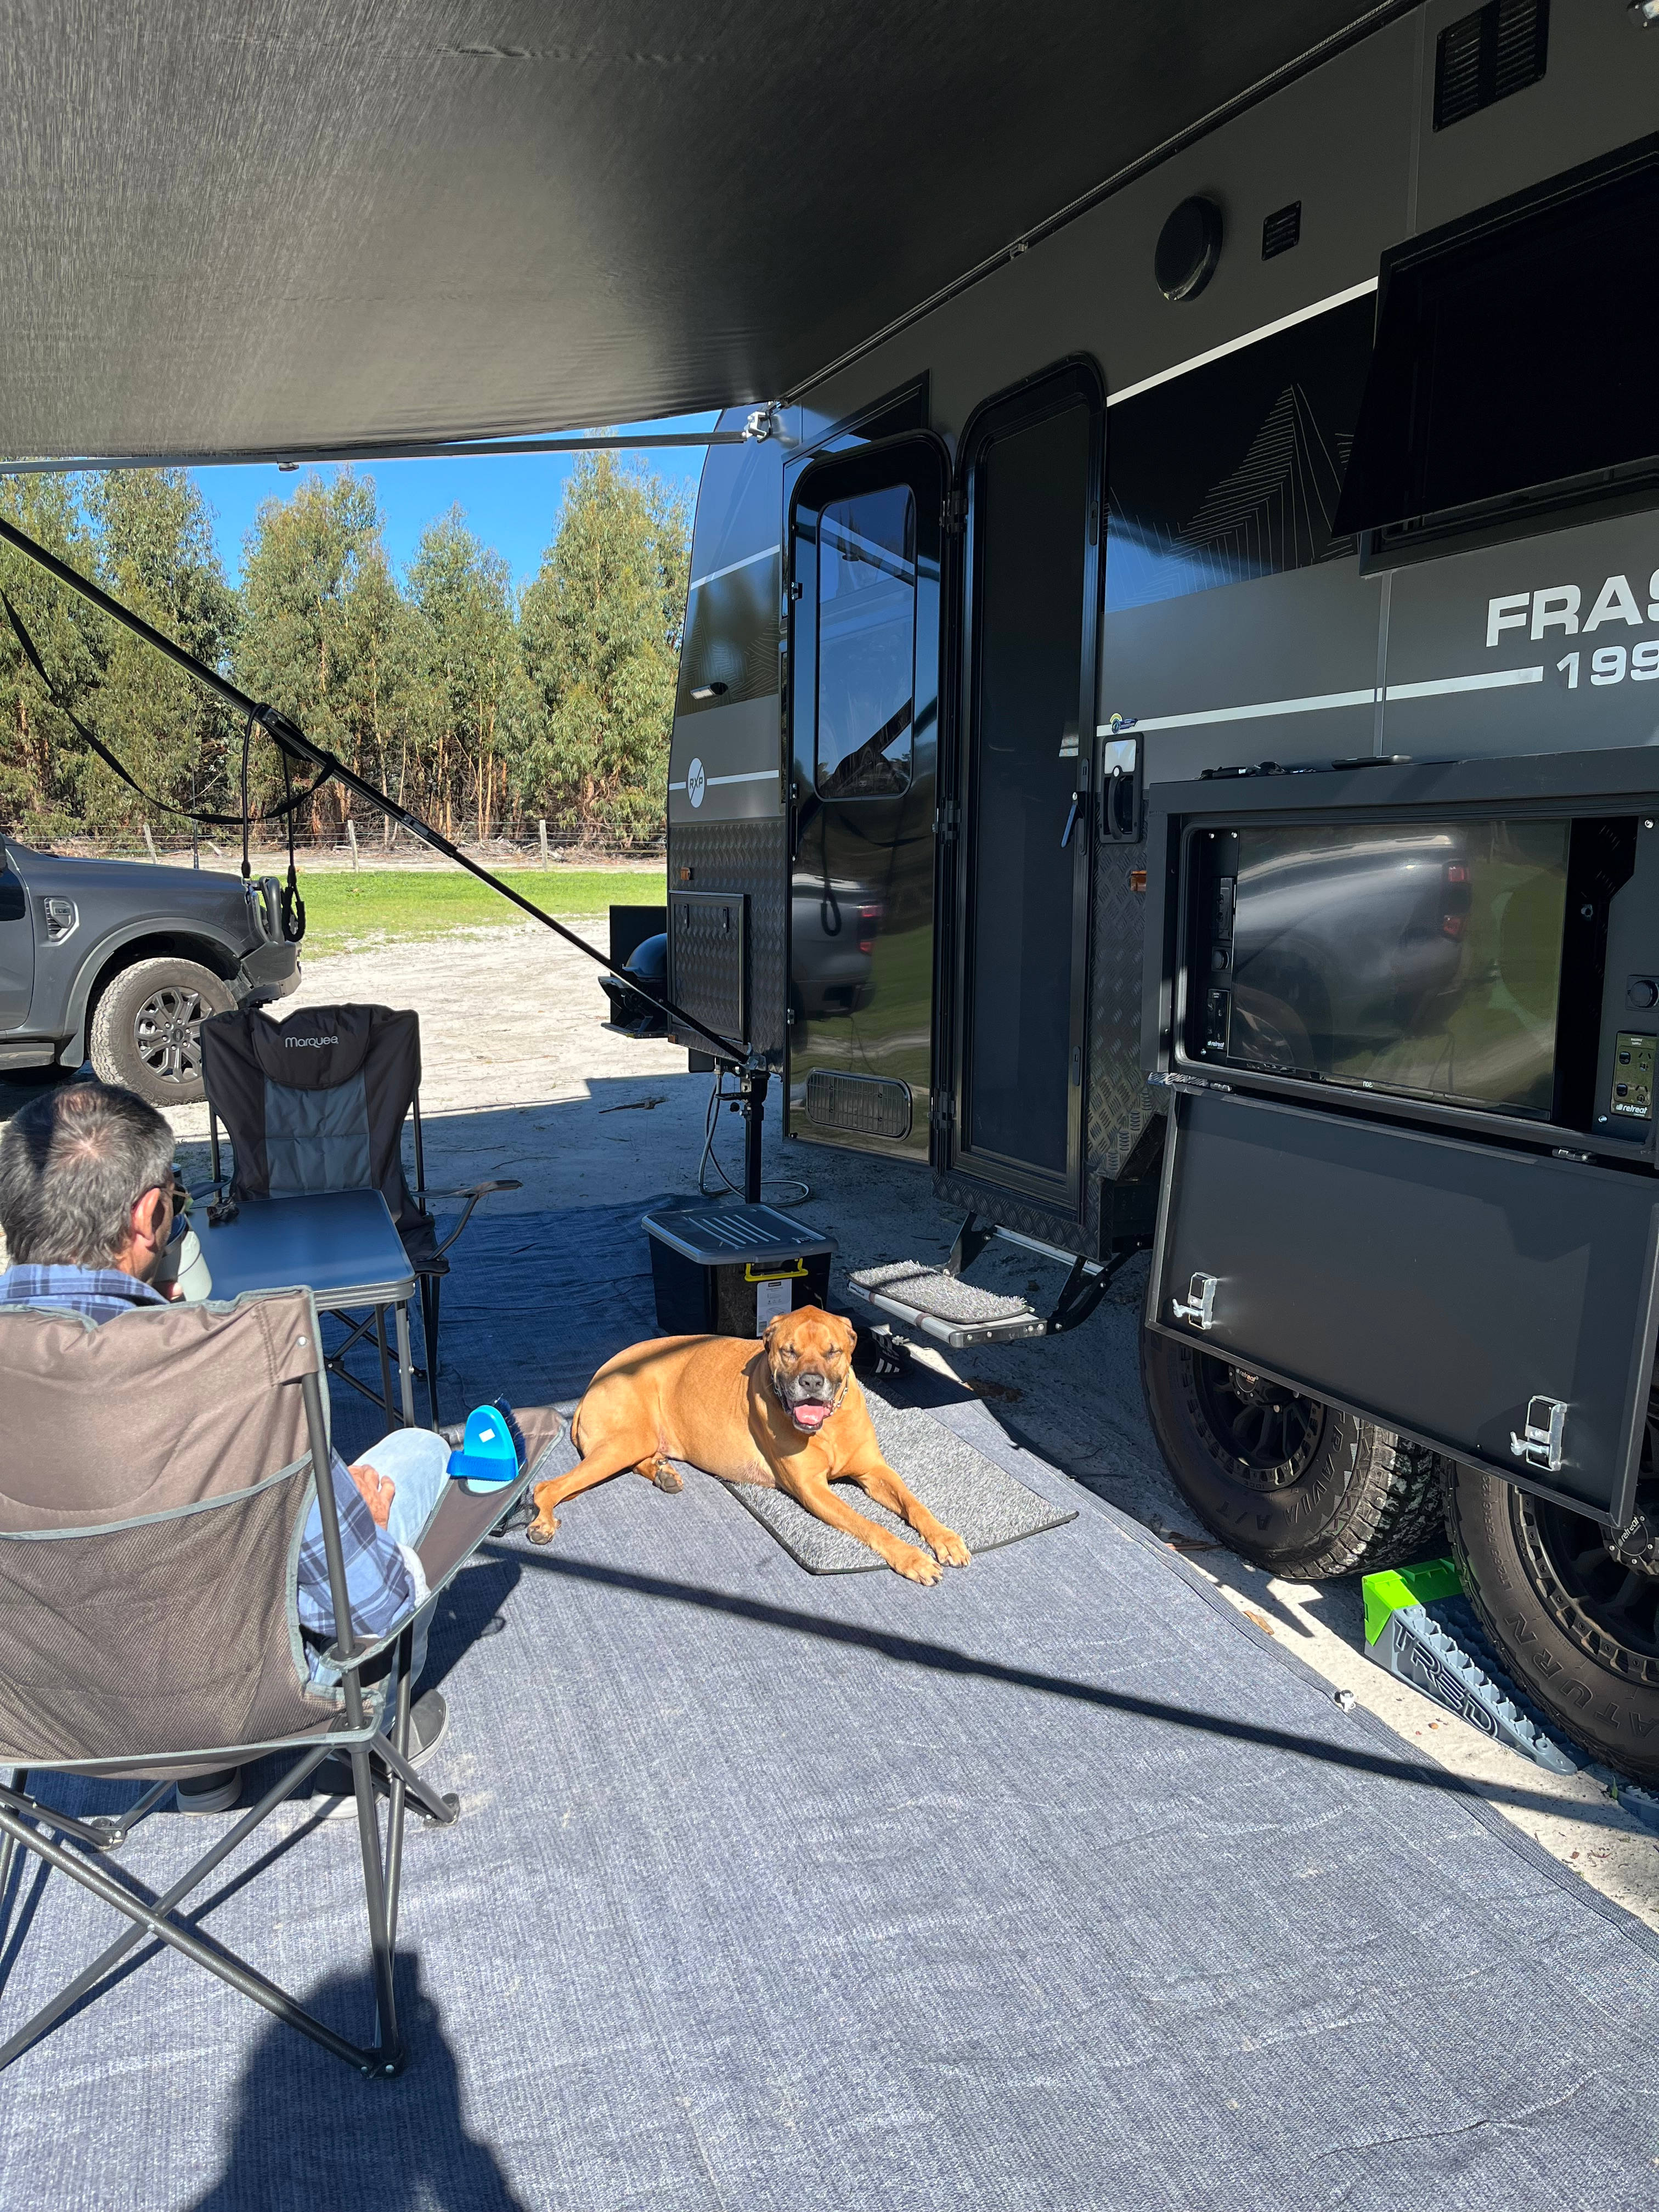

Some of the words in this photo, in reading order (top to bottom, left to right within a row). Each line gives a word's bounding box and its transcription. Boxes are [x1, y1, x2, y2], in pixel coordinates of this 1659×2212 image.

[1486, 569, 1659, 647] FRA
[690, 777, 703, 789] RXP
[1623, 1104, 1647, 1114] retreat
[1621, 1515, 1640, 1543] retreat
